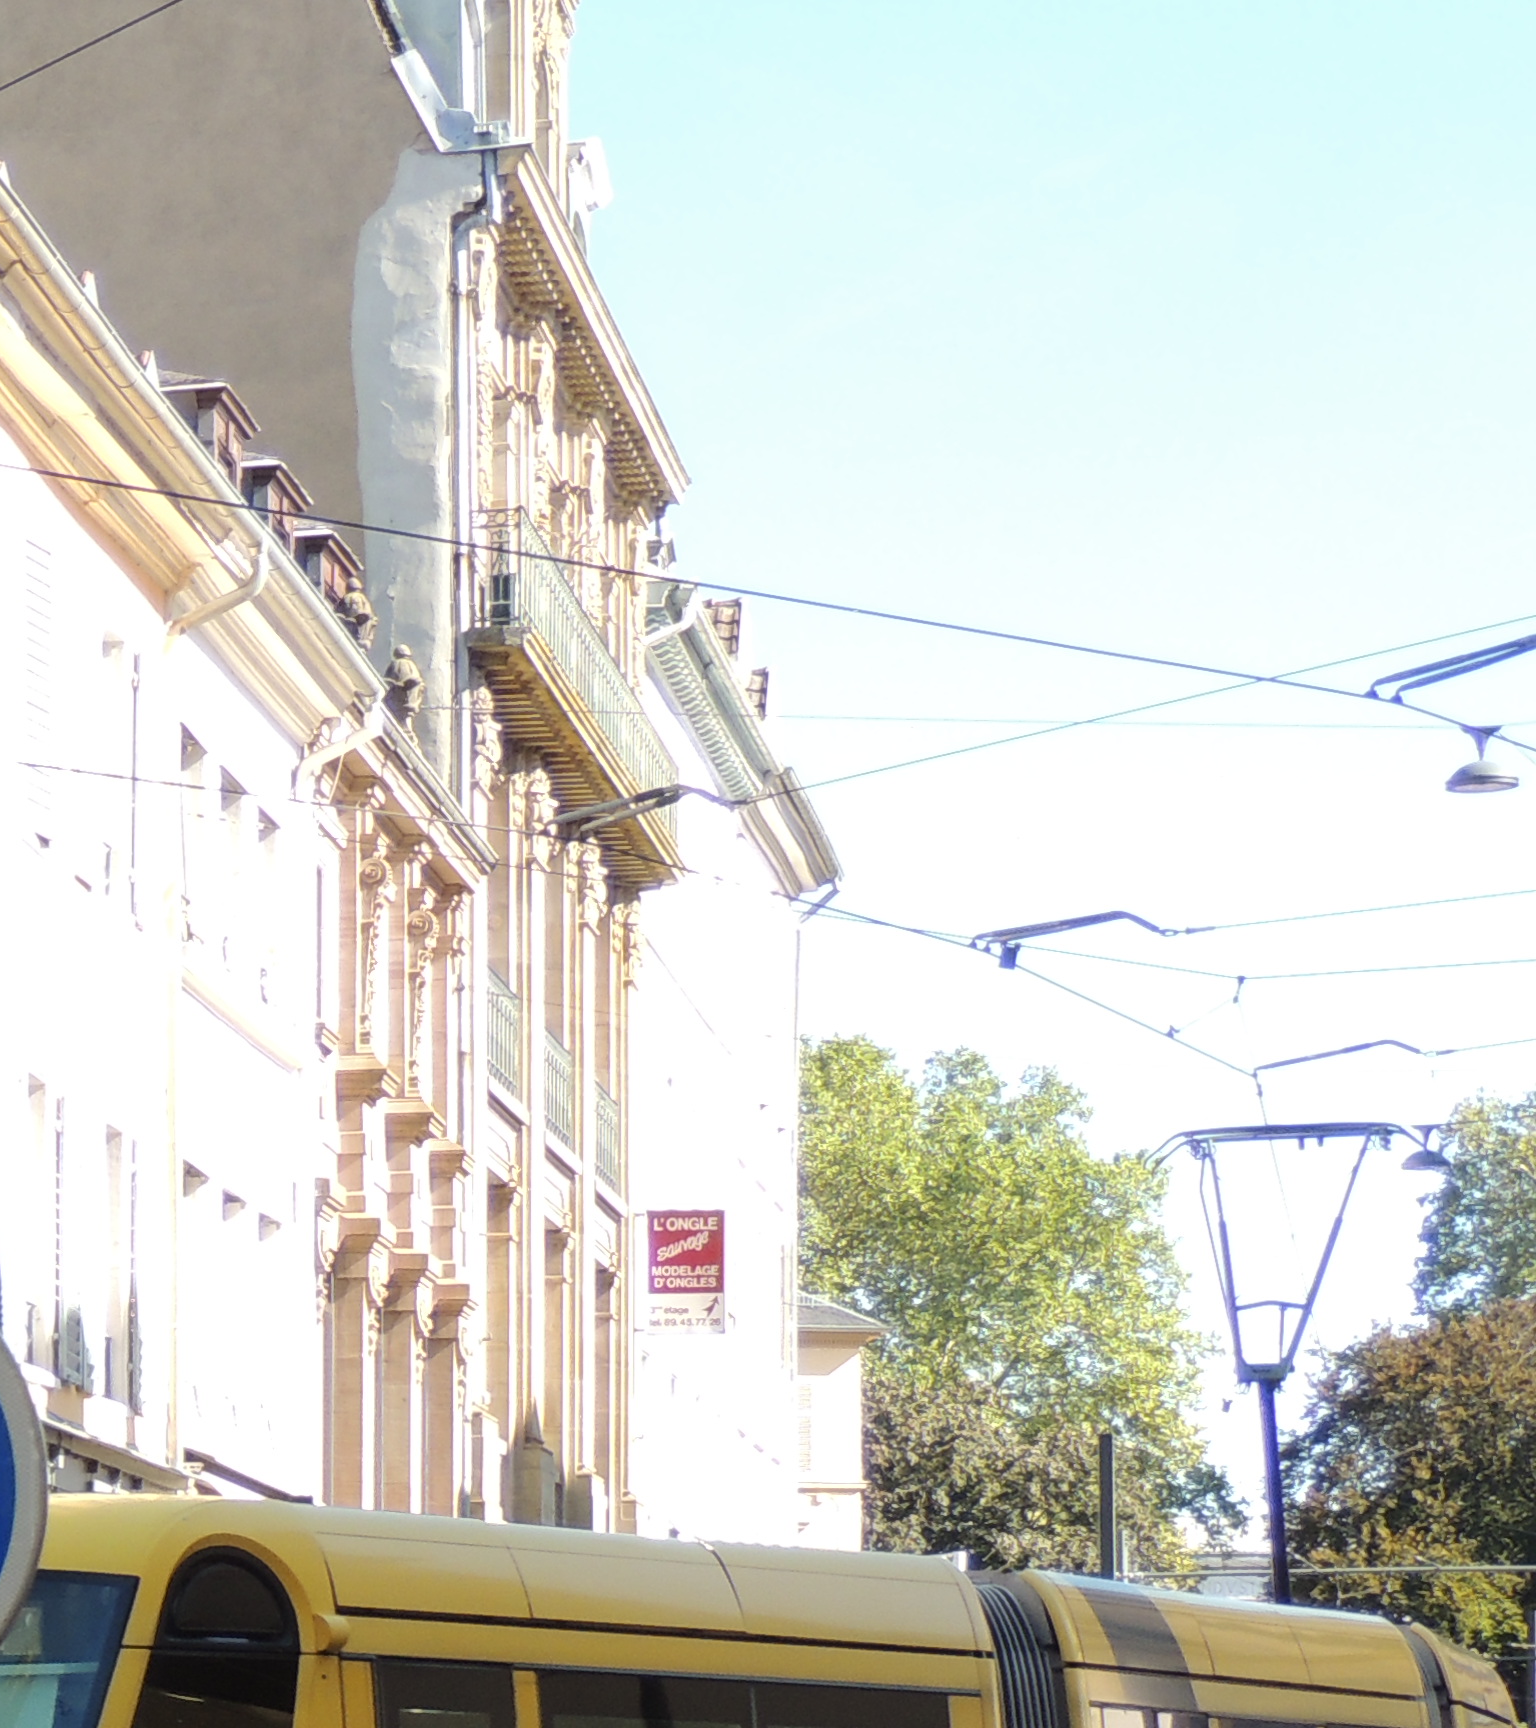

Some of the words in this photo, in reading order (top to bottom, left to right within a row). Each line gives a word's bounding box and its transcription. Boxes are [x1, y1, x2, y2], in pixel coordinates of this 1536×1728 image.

[653, 1217, 718, 1231] L'ONGLE
[651, 1265, 720, 1277] MODELAGE
[654, 1277, 717, 1289] D'ONGLES
